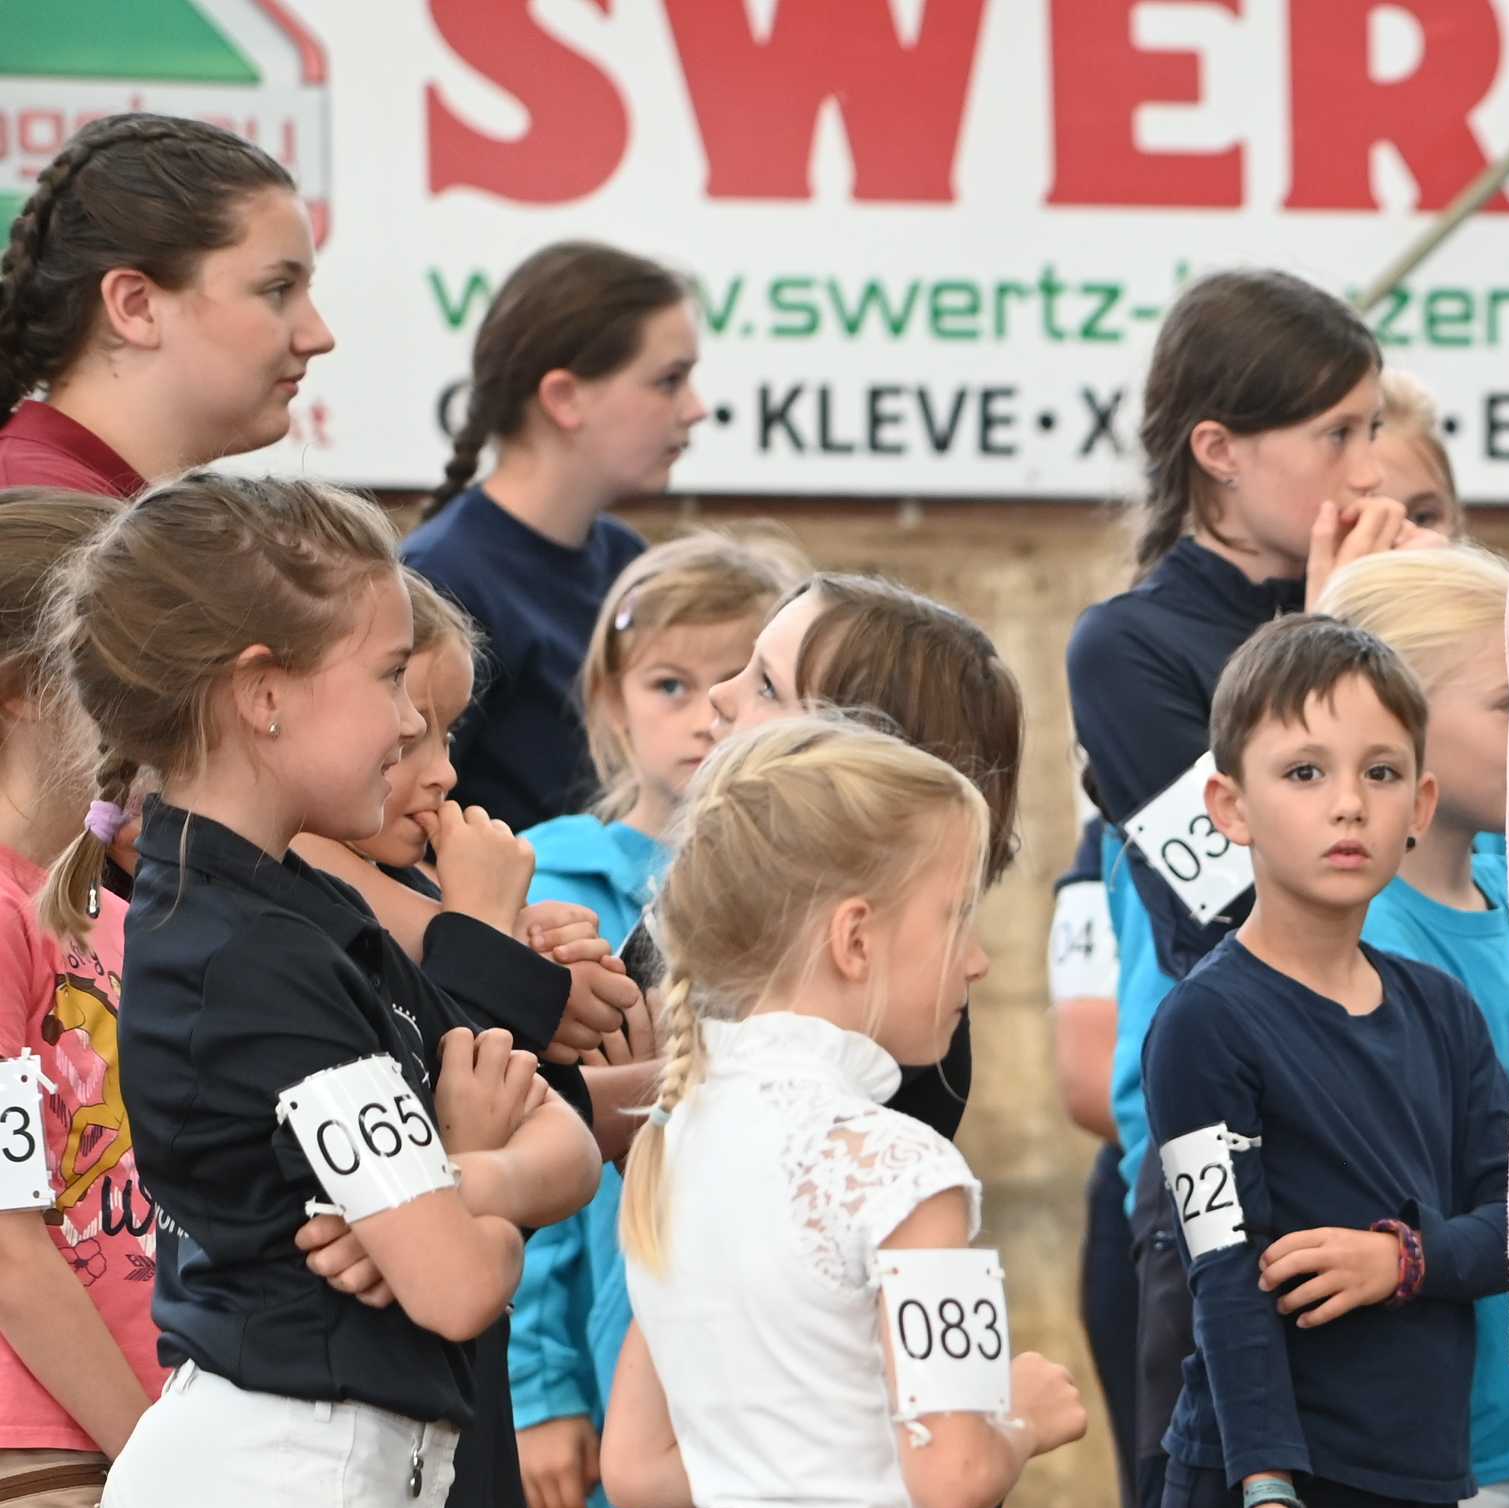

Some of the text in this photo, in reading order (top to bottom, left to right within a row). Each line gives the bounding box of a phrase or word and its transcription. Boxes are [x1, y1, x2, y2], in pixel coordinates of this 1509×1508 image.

[757, 382, 1021, 456] KLEVE
[1161, 814, 1231, 882] 03
[316, 1093, 433, 1176] 065
[898, 1297, 1003, 1361] 083
